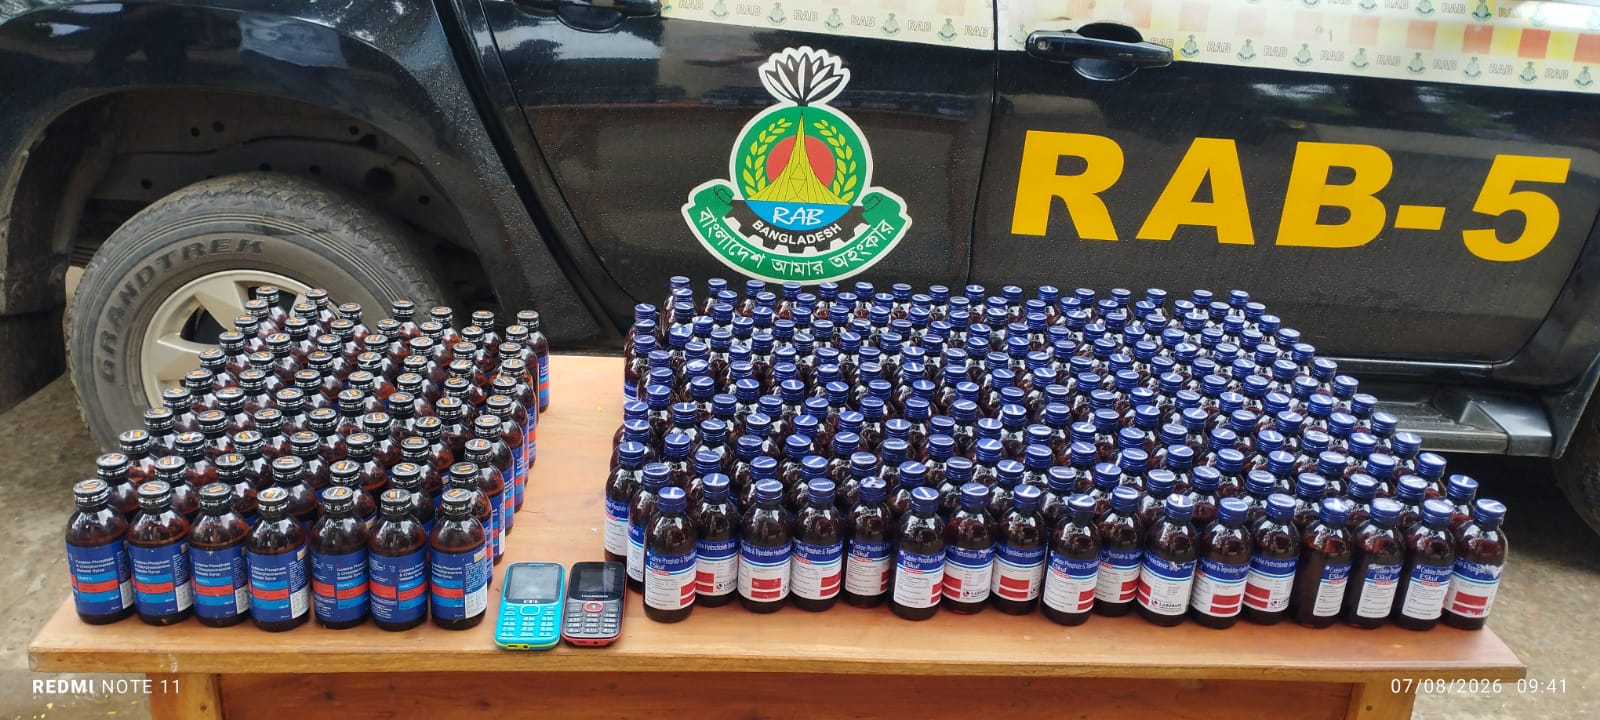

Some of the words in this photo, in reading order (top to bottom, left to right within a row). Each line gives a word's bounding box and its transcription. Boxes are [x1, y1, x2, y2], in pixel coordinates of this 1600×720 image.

[737, 3, 761, 17] RAB
[793, 9, 818, 22] RAB
[851, 15, 875, 28] RAB
[907, 20, 932, 33] RAB
[964, 25, 989, 38] RAB
[1441, 2, 1466, 14] RAB
[1206, 40, 1232, 54] RAB
[1263, 45, 1288, 57] RAB
[1320, 49, 1345, 62] RAB
[1376, 54, 1401, 67] RAB
[1432, 58, 1458, 71] RAB
[1488, 63, 1513, 76] RAB
[1544, 67, 1569, 80] RAB
[1011, 130, 1571, 262] RAB-5
[752, 219, 842, 245] BANGLADESH
[773, 206, 824, 225] RAB
[699, 206, 766, 268] বাংলাদেশ
[771, 258, 824, 276] আমার
[828, 219, 895, 267] অহংকার
[99, 238, 265, 383] GRANDTREK
